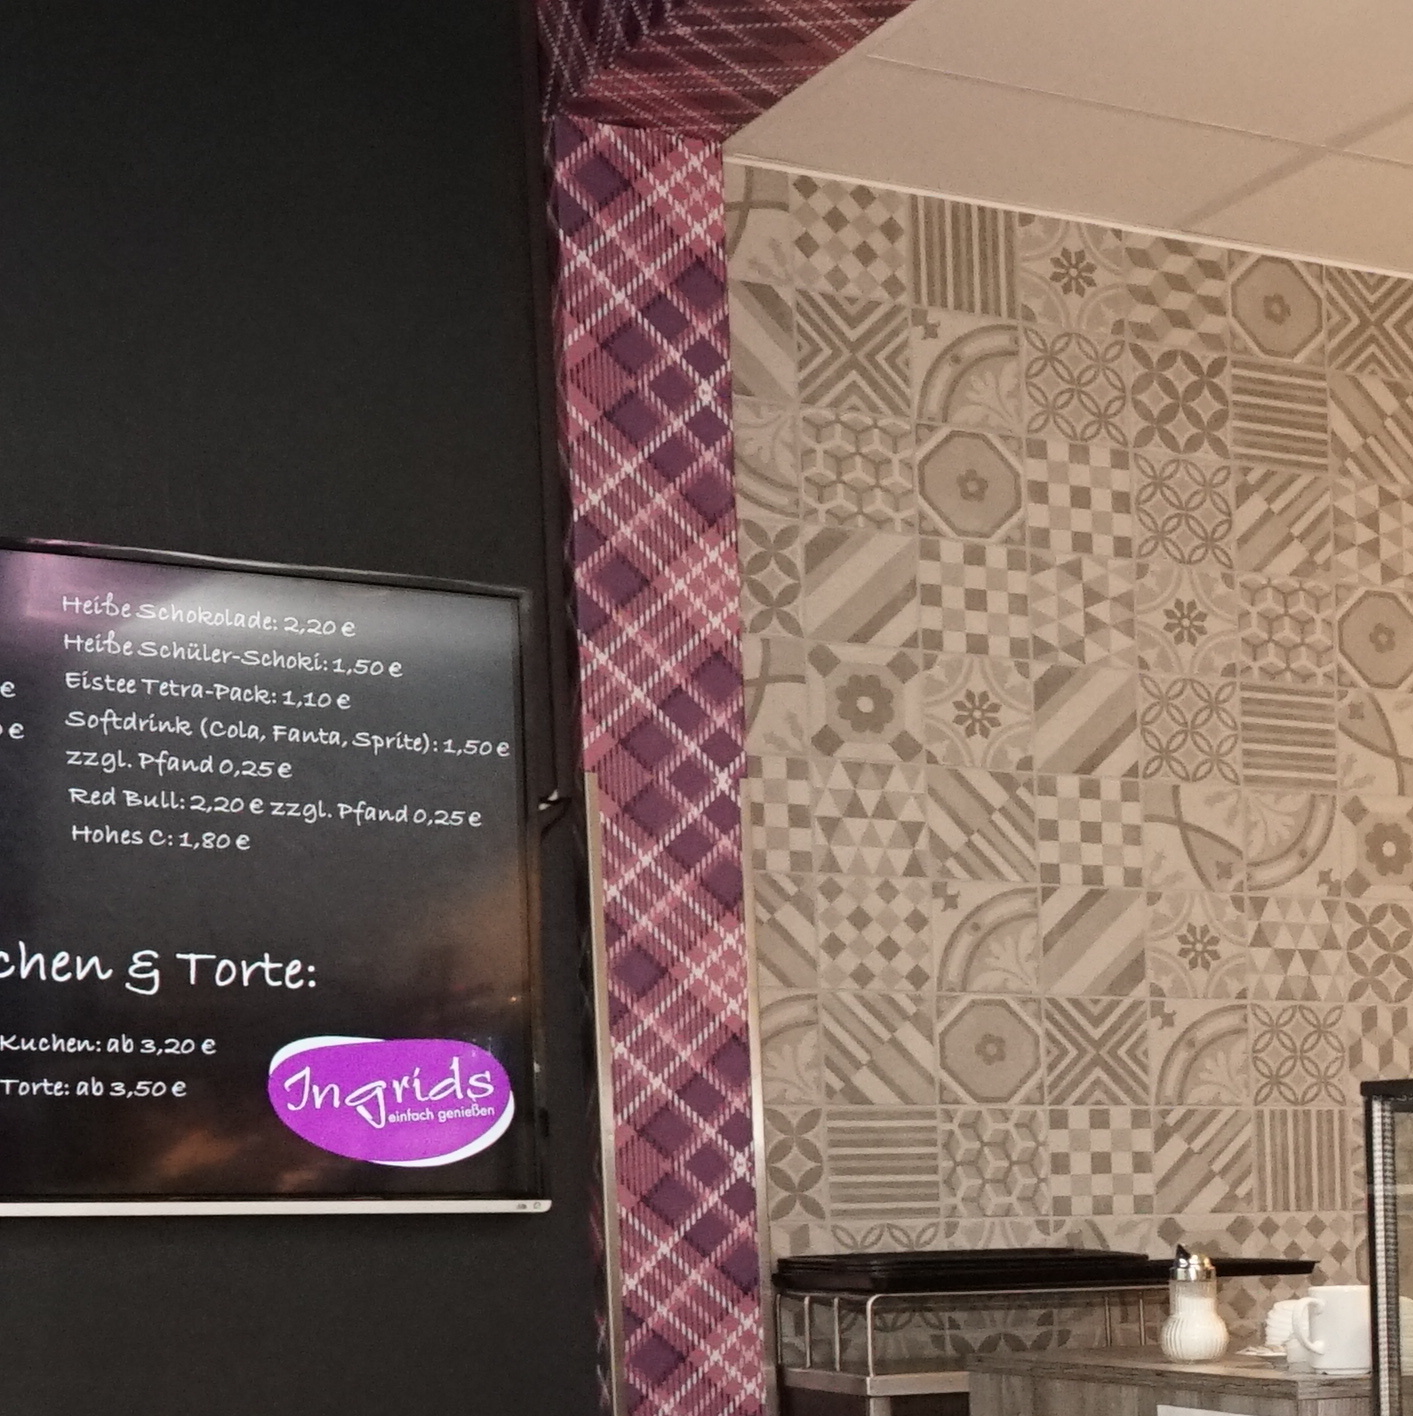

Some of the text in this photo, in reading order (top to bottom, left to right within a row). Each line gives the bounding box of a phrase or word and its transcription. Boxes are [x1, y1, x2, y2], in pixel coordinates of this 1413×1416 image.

[62, 593, 356, 637] Heiße Schokolade: 2,20 €
[63, 632, 403, 678] Heiße Schüler-Schoki: 1,50 €
[0, 680, 16, 698] €
[65, 672, 352, 710] Eistee Tetra-Pack: 1,10 €
[8, 722, 25, 740] €
[65, 710, 511, 758] Softdrink (Cola, Fanta, Sprite): 1,50 €
[65, 750, 293, 780] zzgl. Pfand 0,25 €
[69, 787, 482, 829] Red Bull: 2,20 € zzgl. Pfand 0,25 €
[71, 825, 251, 851] Hohes C: 1,80 €
[126, 949, 161, 994] &
[176, 952, 317, 989] Torte:
[0, 1034, 217, 1057] Kuchen: ab 3,20 €
[0, 1079, 188, 1100] Torte: ab 3,50 €
[284, 1056, 496, 1130] Ingrids
[388, 1102, 496, 1125] einfach genießen
